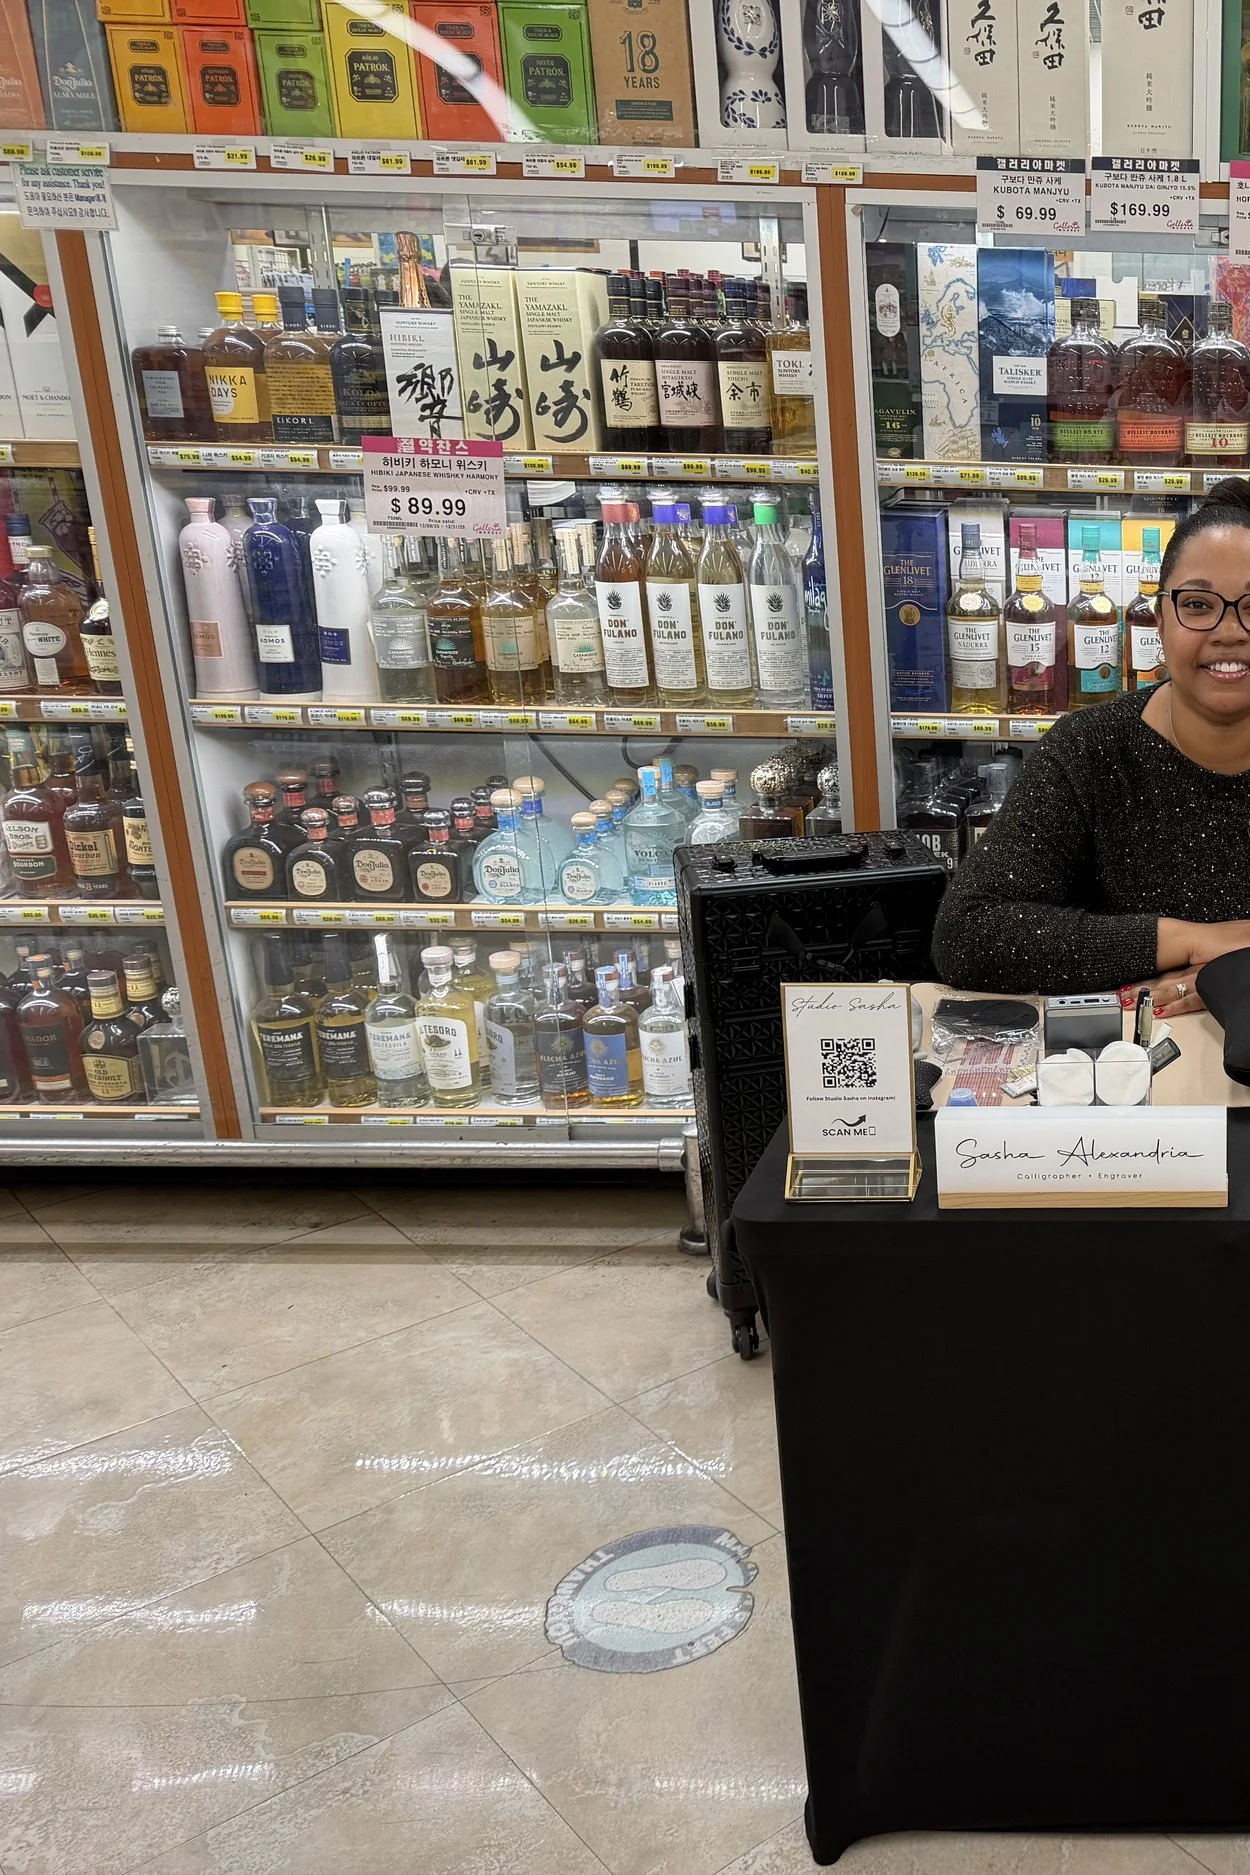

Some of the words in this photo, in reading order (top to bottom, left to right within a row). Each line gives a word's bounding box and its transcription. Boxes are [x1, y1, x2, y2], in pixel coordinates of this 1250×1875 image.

[620, 31, 660, 73] 18
[624, 76, 660, 89] YEARS
[72, 179, 91, 188] Thank
[993, 186, 1029, 194] KUBOTA
[1033, 188, 1069, 196] MANJYU
[1016, 206, 1057, 220] 69.99
[1111, 201, 1170, 217] $169.99
[998, 367, 1041, 376] TALISKER
[209, 375, 247, 385] NIKKA
[211, 388, 238, 398] DAYS
[1030, 416, 1041, 427] 10
[382, 457, 415, 468] 히비키
[420, 458, 452, 470] 하모니
[457, 459, 486, 471] 위스키
[408, 497, 466, 516] 89.99
[884, 566, 931, 575] GLENLIVET
[902, 576, 914, 585] 18
[708, 630, 743, 640] FULANO
[791, 994, 843, 1018] Studio
[848, 991, 902, 1012] Sasha
[955, 1138, 1046, 1169] Sasha
[1057, 1136, 1204, 1167] Alexandria
[1016, 1172, 1082, 1180] Calligrapher
[1098, 1172, 1143, 1180] Engraver
